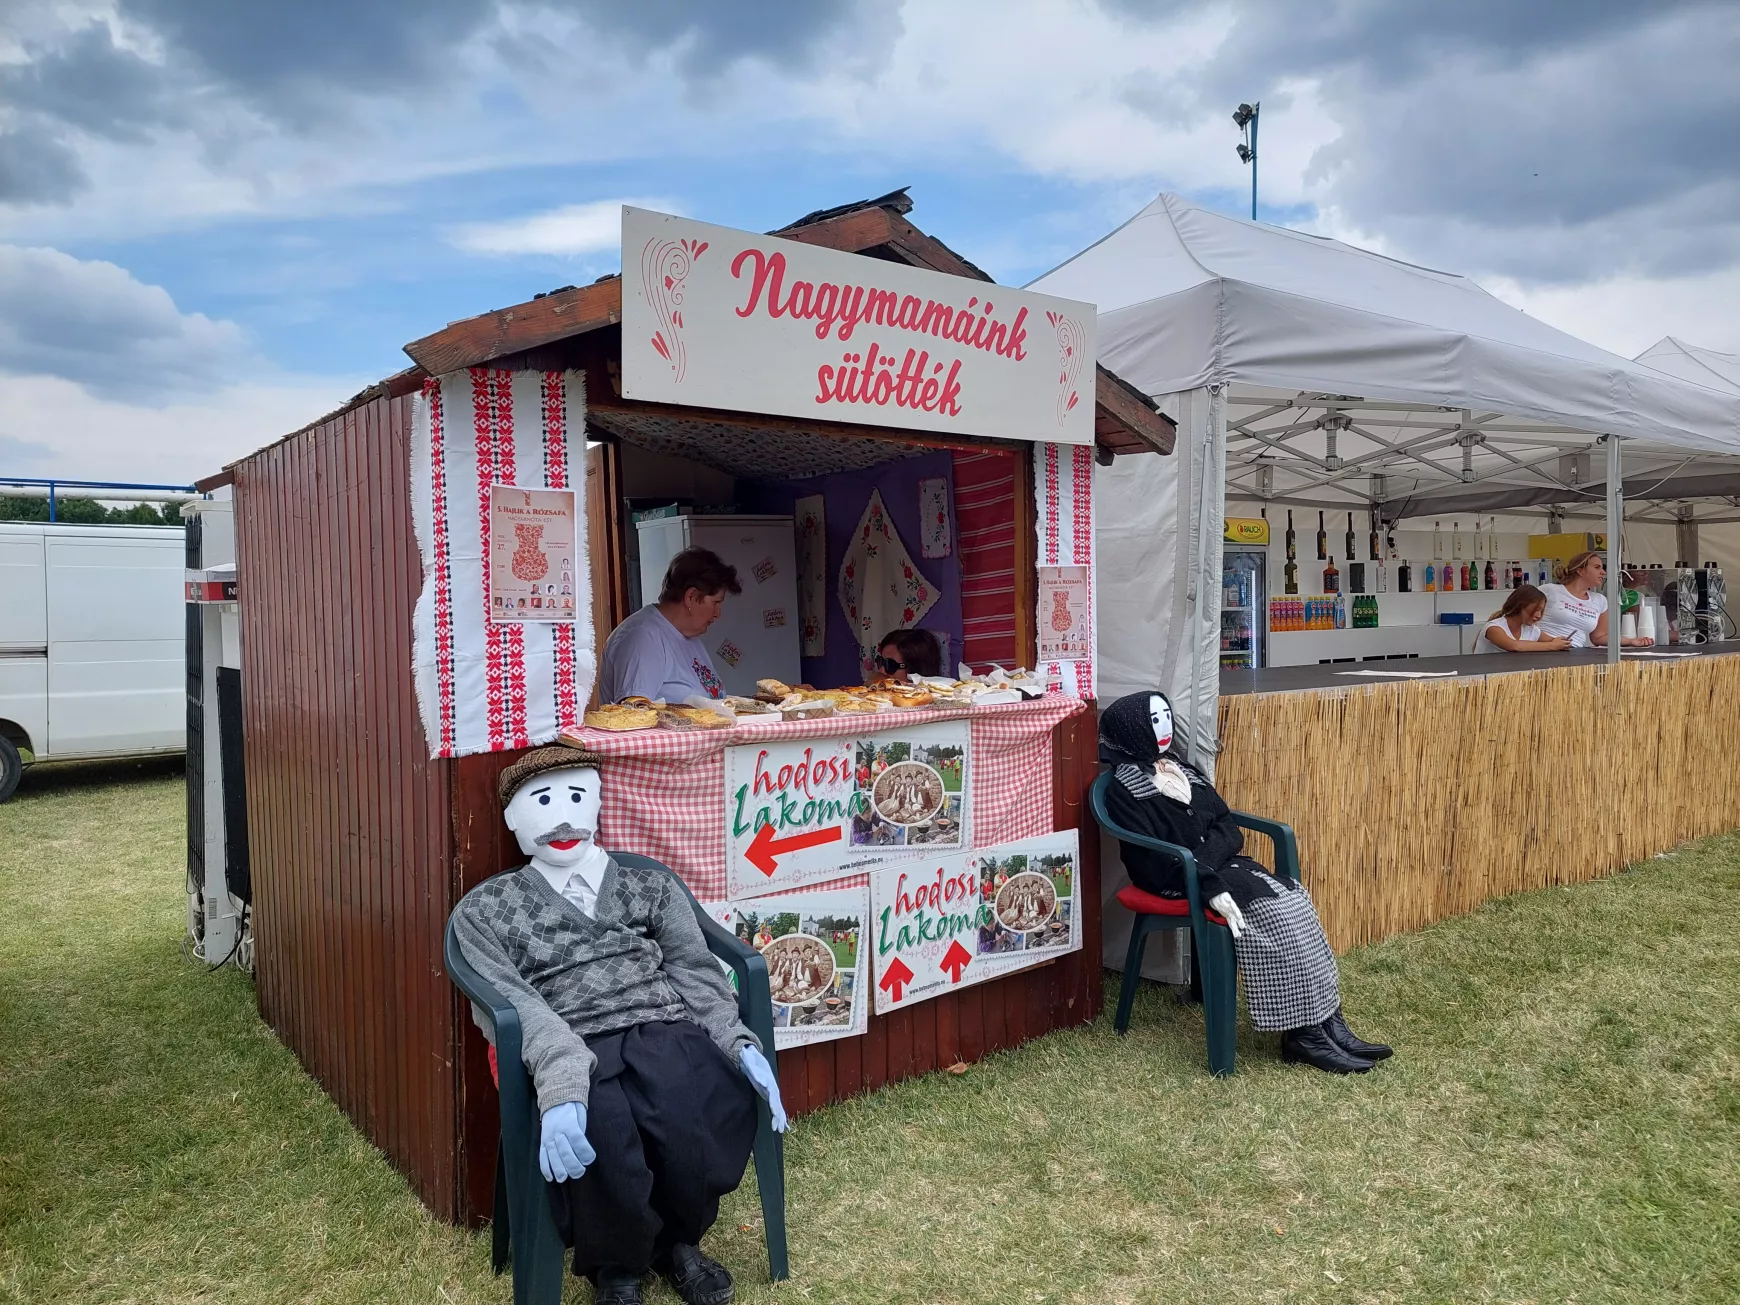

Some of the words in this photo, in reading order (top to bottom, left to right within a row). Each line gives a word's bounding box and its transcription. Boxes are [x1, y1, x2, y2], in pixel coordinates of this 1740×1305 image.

[730, 248, 1029, 361] Nagymamáink
[815, 343, 962, 417] sütötték
[1243, 525, 1261, 534] RAUCH
[752, 743, 852, 799] hodosi
[895, 860, 978, 916] hodosi
